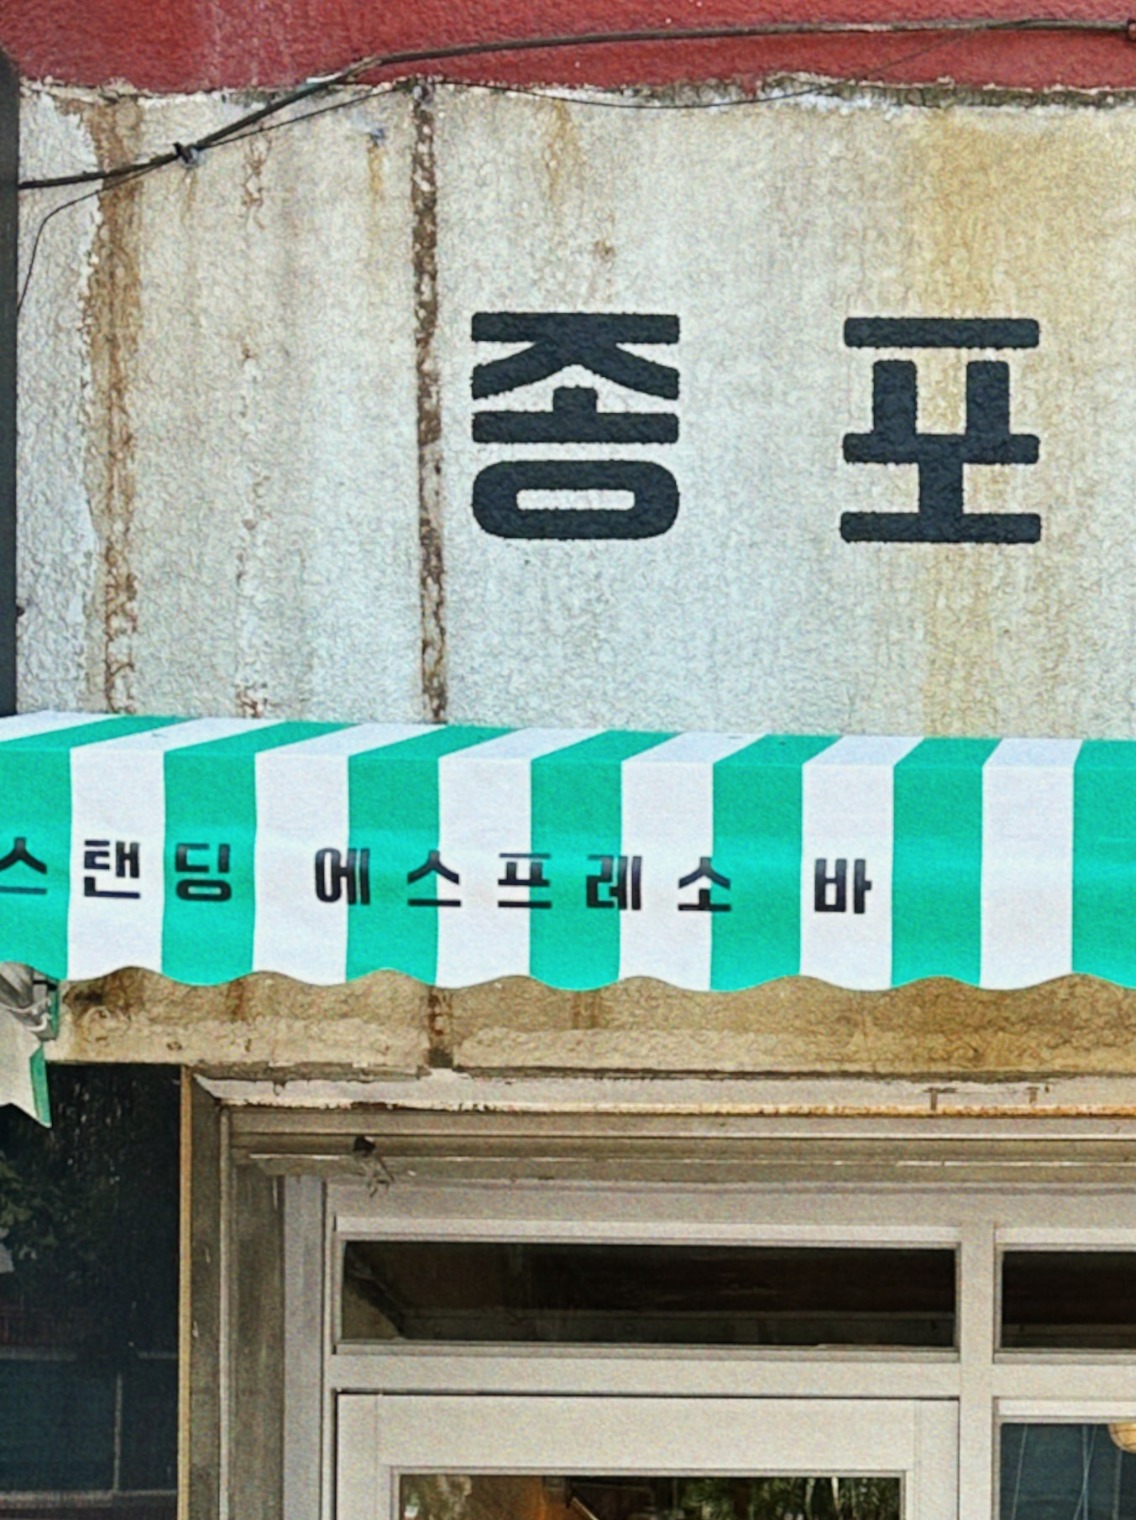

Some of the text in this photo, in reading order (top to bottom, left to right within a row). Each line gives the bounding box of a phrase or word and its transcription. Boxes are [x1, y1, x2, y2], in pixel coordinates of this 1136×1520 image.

[0, 837, 874, 916] 스탠딩 에스프레소 바
